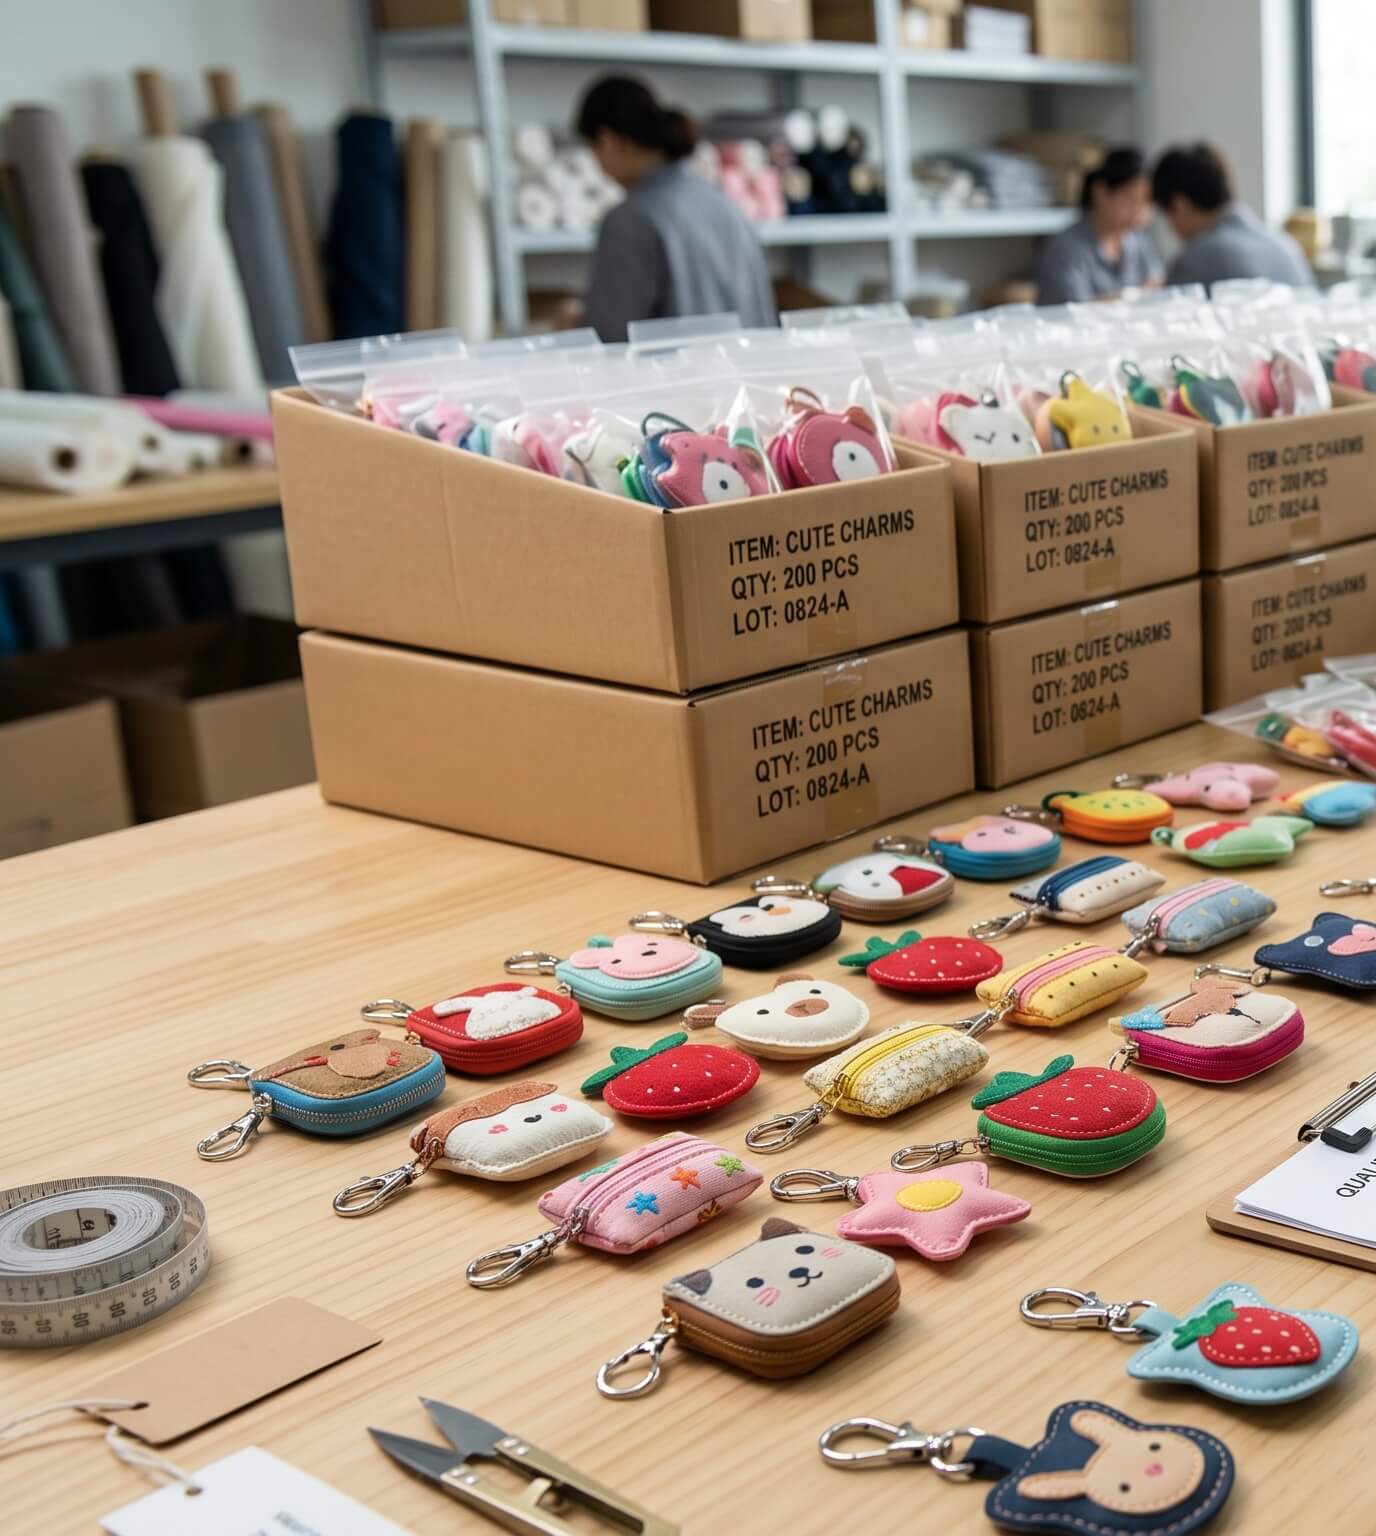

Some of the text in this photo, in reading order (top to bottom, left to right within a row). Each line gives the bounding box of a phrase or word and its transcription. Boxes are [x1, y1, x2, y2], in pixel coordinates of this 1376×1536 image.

[1282, 443, 1313, 466] CUTE
[1025, 469, 1168, 512] ITEM: CUTE CHARMS
[1304, 468, 1328, 488] PCS
[729, 509, 915, 565] ITEM: CUTE CHARMS
[1025, 506, 1125, 542] QTY: 200 PCS
[1026, 536, 1115, 573] LOT: 0824-A
[731, 554, 860, 600] QTY: 200 PCS
[733, 589, 849, 636] LOT: 0824-A
[1032, 621, 1172, 675] ITEM: CUTE CHARMS
[1032, 661, 1129, 704] QTY: 200 PCS
[753, 679, 933, 749] ITEM: CUTE CHARMS
[1032, 692, 1120, 735] LOT: 0824-A
[755, 727, 880, 783] QTY: 200 PCS
[757, 763, 870, 817] LOT: 0824-A
